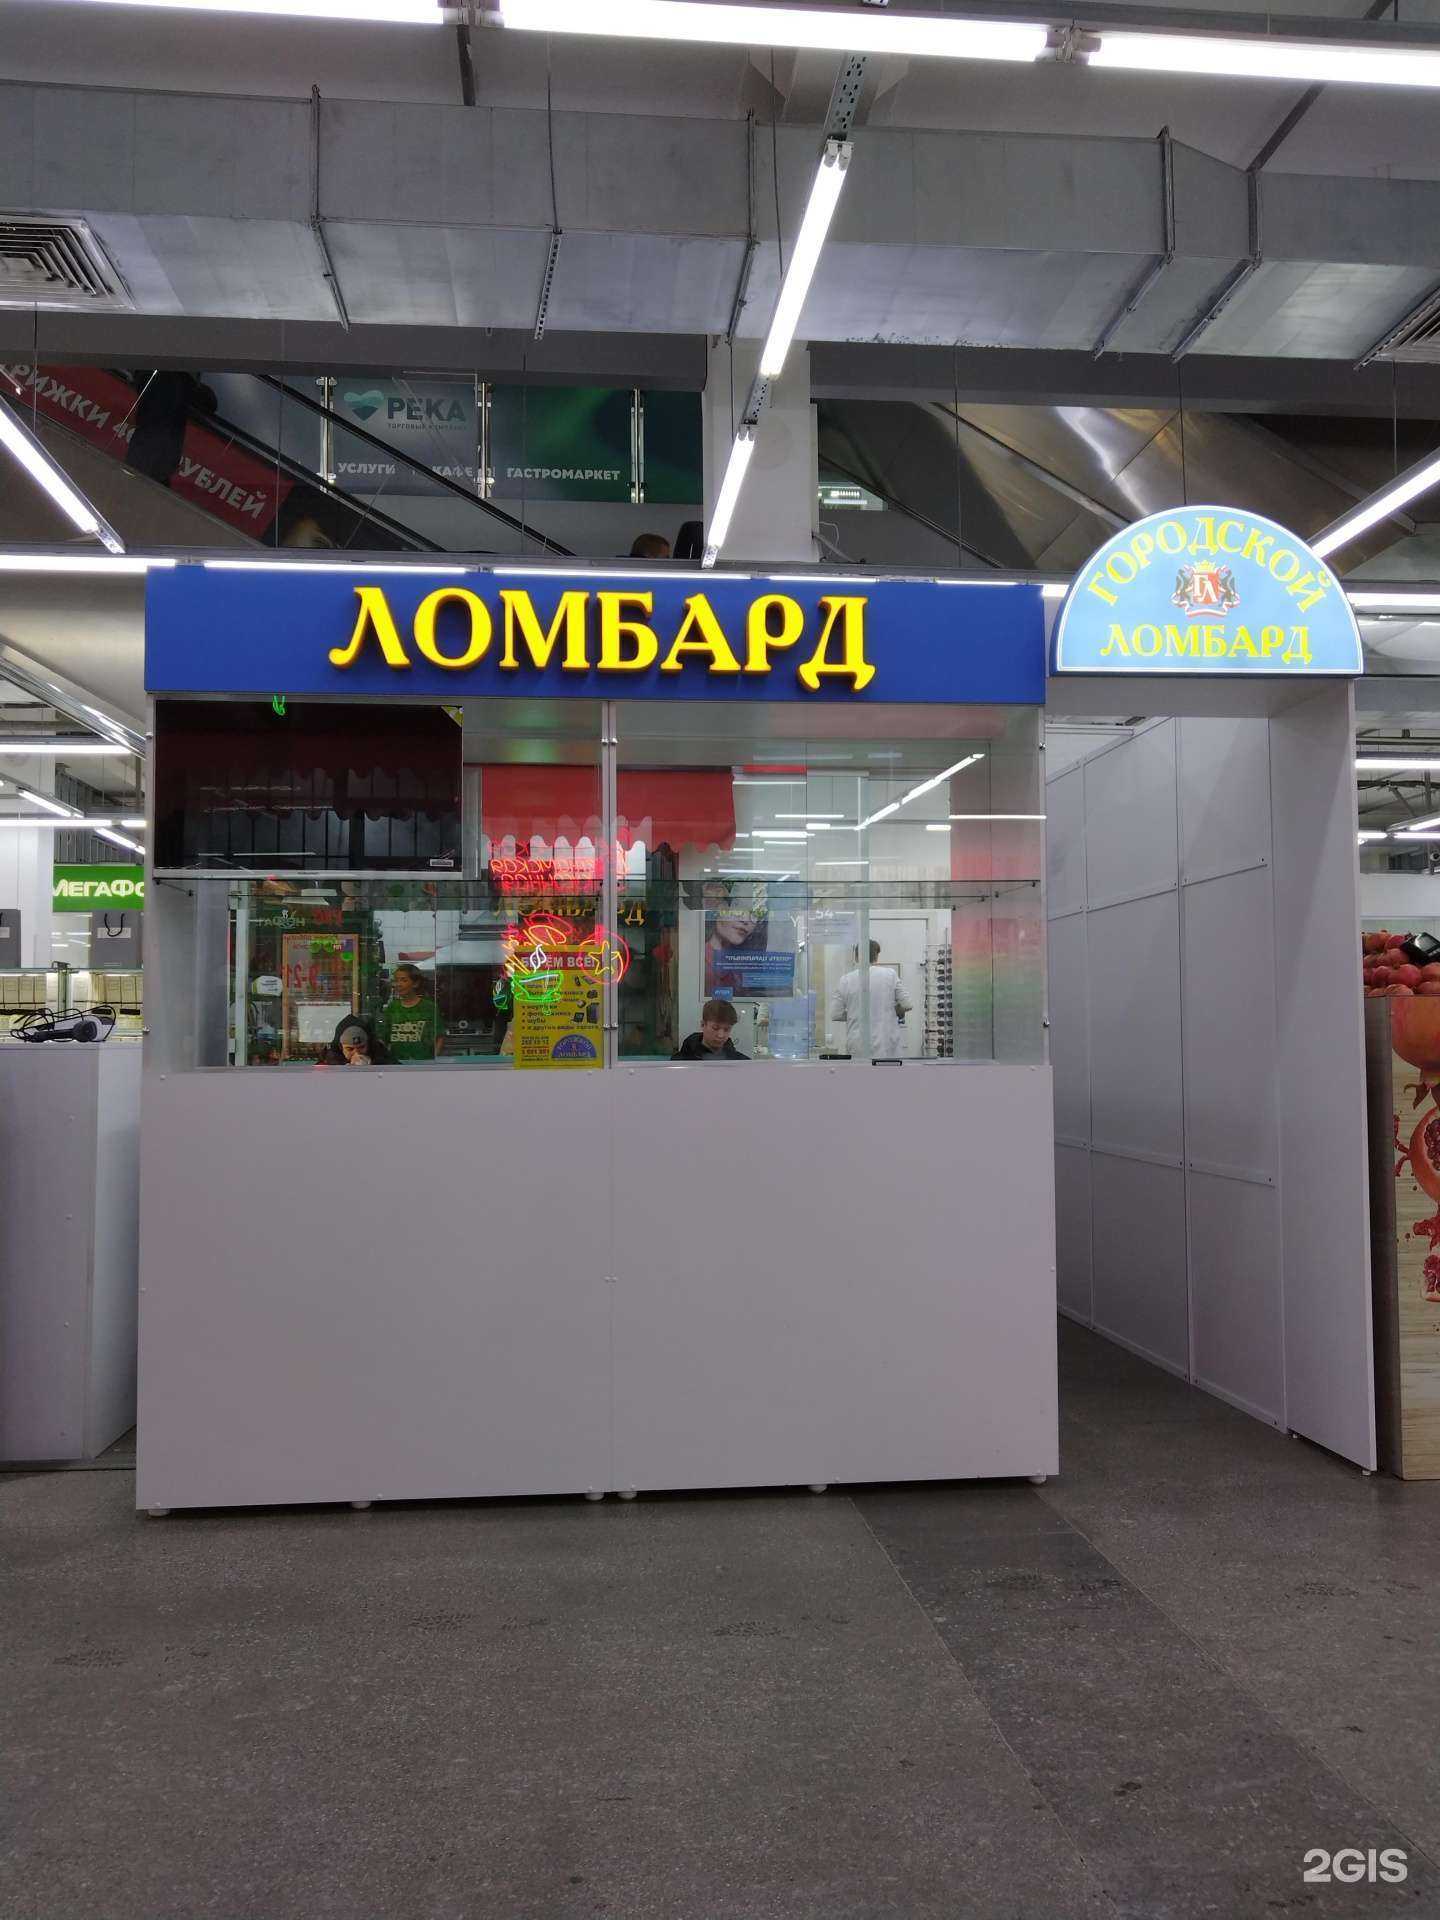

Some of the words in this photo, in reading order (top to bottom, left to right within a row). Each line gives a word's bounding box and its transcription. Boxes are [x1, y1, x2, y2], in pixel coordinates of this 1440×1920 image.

[0, 363, 111, 429] РИЖКИ
[178, 455, 268, 520] УБЛЕЙ
[387, 396, 467, 422] РЕКА
[337, 461, 396, 475] УСЛУГИ
[432, 465, 474, 478] КАФЕ
[506, 466, 621, 481] ГАСТРОМАРКЕТ
[1088, 517, 1332, 613] ГОРОДСКОЙ
[329, 586, 876, 692] ЛОМБАРД
[1100, 624, 1313, 664] ЛОМБАРД
